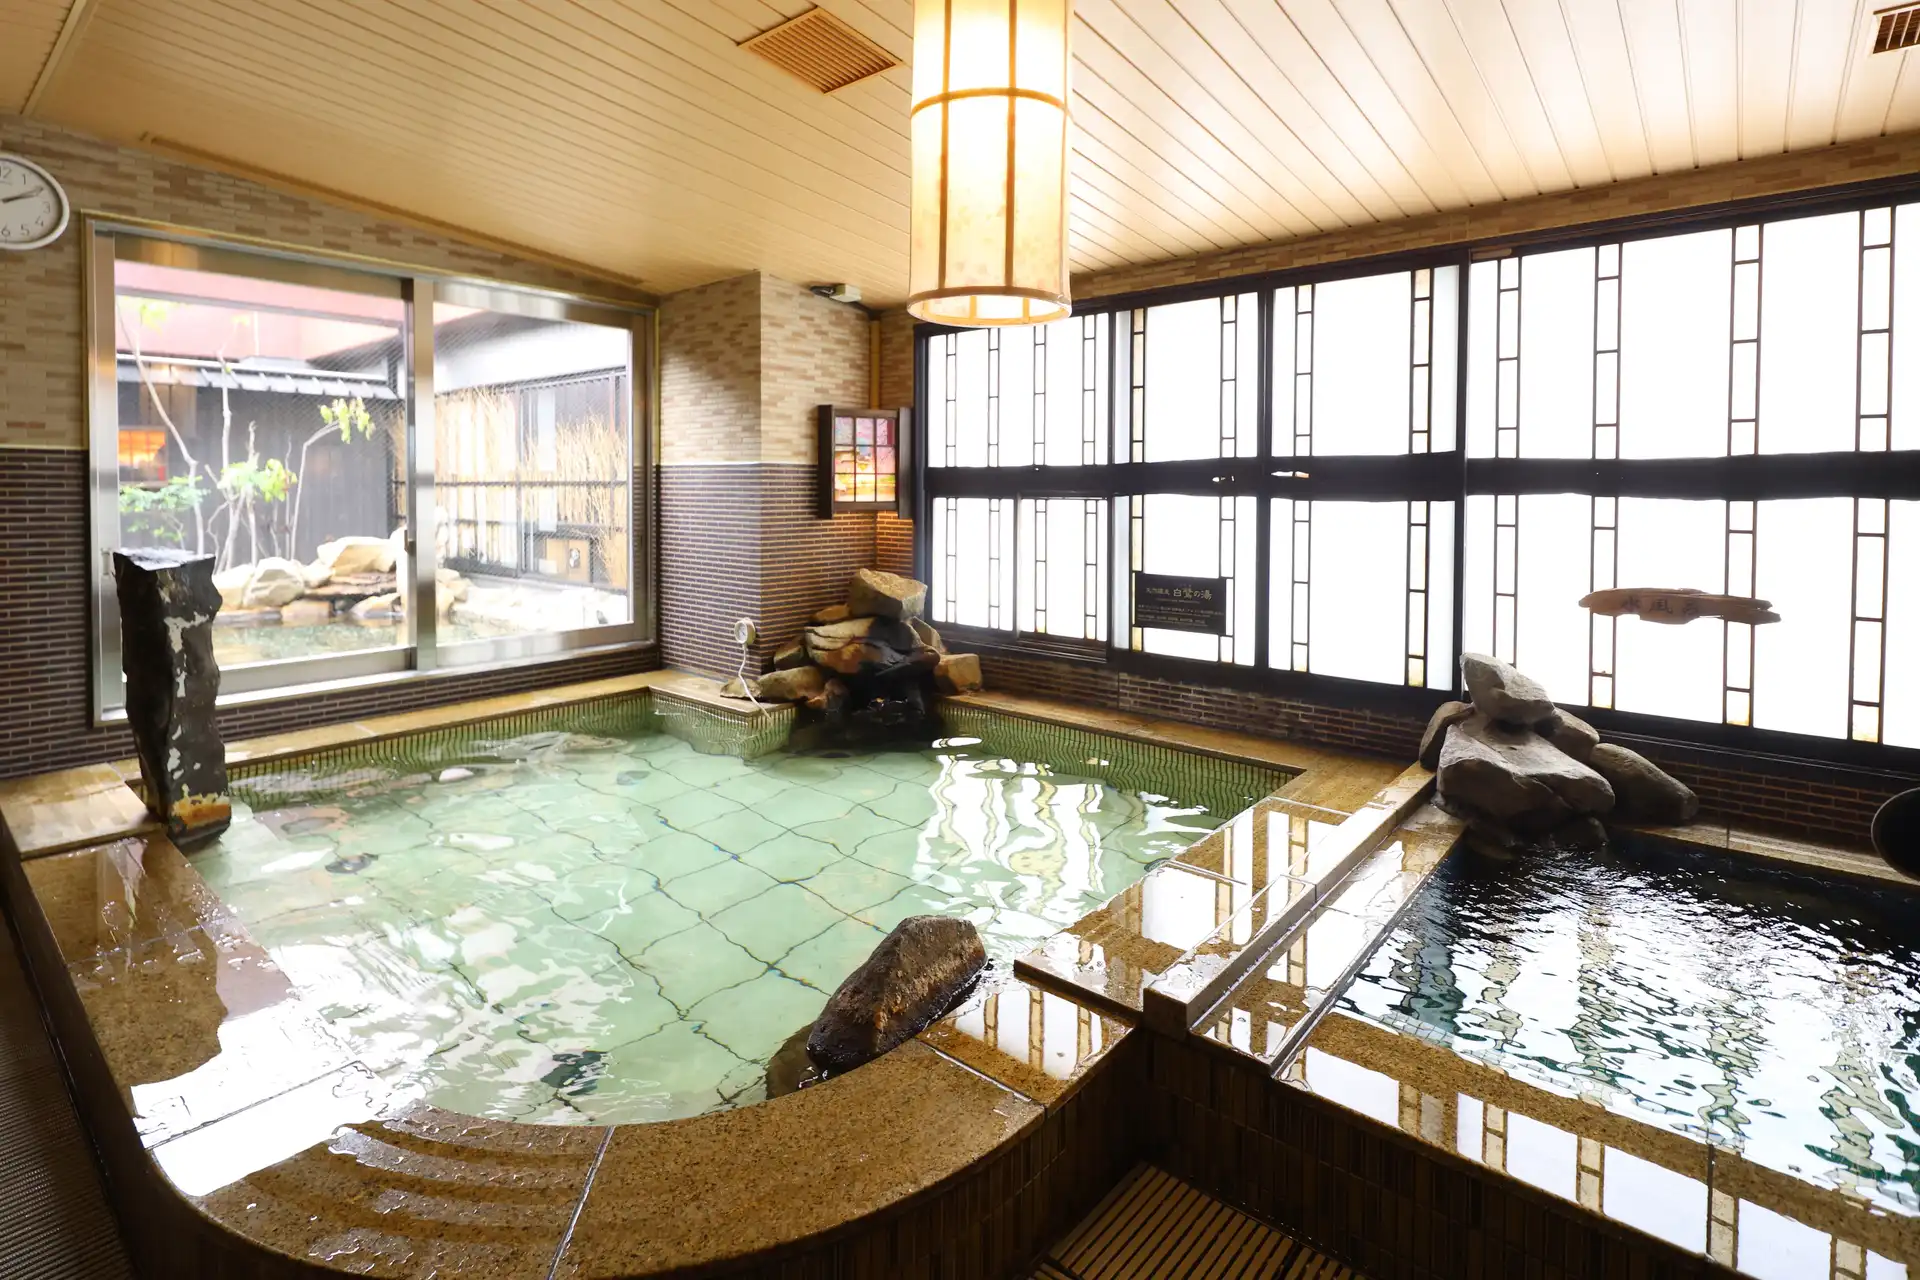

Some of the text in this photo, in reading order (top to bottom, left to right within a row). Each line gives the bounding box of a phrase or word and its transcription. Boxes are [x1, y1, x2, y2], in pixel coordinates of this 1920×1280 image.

[22, 173, 27, 185] 1
[42, 201, 50, 214] 3
[34, 215, 44, 227] 4
[1, 222, 11, 236] 6
[20, 224, 29, 236] 5
